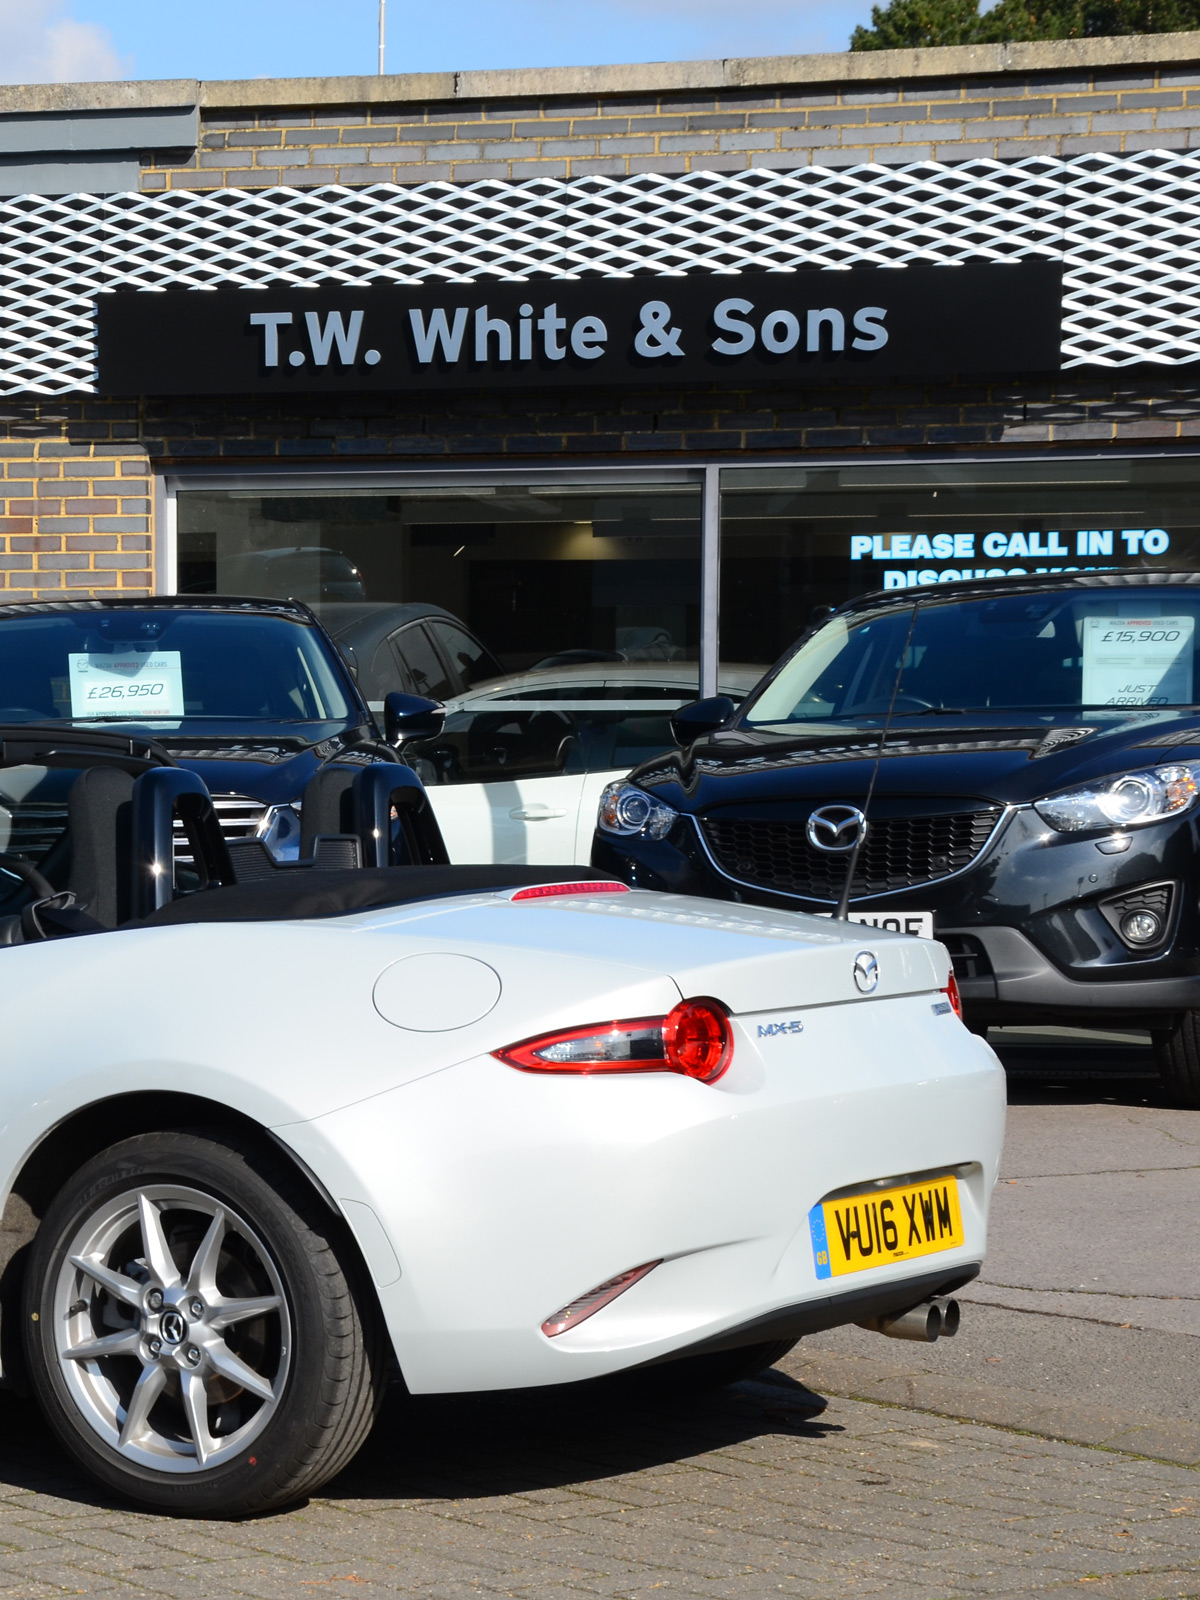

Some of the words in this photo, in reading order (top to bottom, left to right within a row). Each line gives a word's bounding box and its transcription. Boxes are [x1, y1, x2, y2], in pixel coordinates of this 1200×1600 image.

[250, 311, 381, 367] T.W.
[408, 303, 607, 363] White
[634, 300, 685, 357] &
[711, 297, 889, 355] Sons
[850, 533, 975, 560] PLEASE
[982, 531, 1068, 557] CALL
[1076, 530, 1113, 555] IN
[1121, 528, 1169, 555] TO
[1101, 630, 1181, 643] £15,900
[87, 683, 164, 700] £26,950
[1118, 684, 1158, 693] JUST
[756, 1020, 804, 1038] MX-5
[834, 1199, 898, 1260] VU16
[902, 1186, 953, 1246] XWM
[817, 1250, 828, 1265] GB
